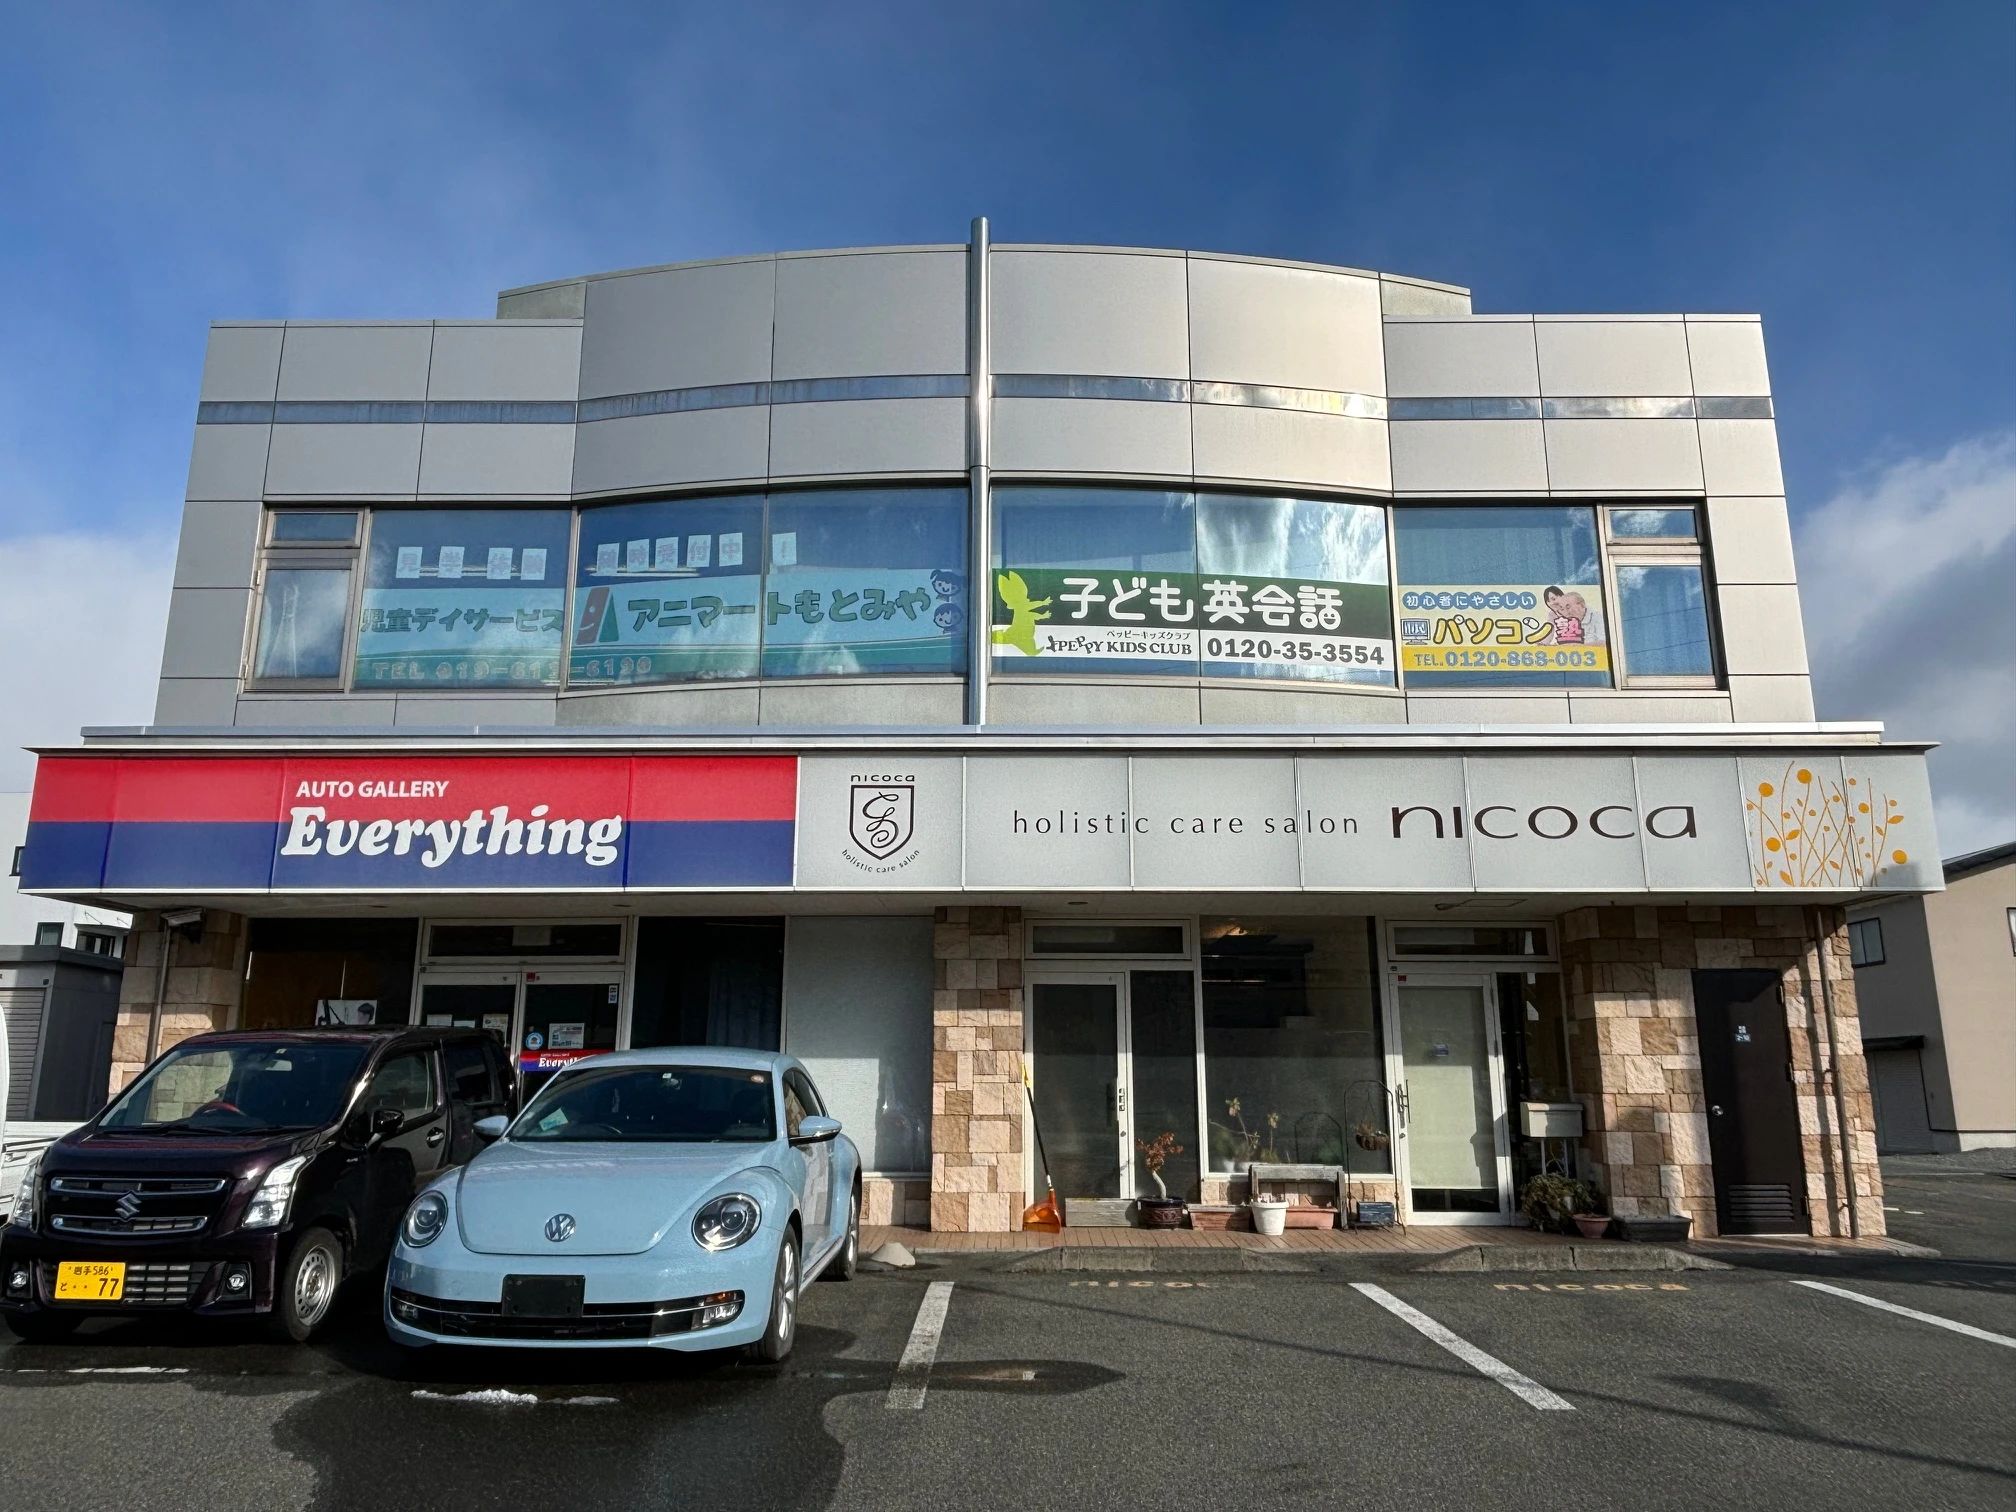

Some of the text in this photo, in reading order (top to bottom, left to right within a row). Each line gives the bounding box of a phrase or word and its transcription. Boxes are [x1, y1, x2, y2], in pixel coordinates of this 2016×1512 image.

[361, 586, 931, 633] 児童デイサービス アニマートもとみや
[1060, 577, 1343, 630] 子ども英会話
[1406, 594, 1535, 607] 初心者にやさしい
[1058, 635, 1192, 655] PEPPY KIDS CLUB
[1207, 637, 1384, 665] 0120-35-3554
[1445, 650, 1597, 667] 0120-868-003
[372, 662, 425, 680] TEL
[850, 774, 915, 782] nicoca
[296, 781, 450, 798] AUTO GALLERY
[1013, 805, 1698, 839] holistic care salon nicoca
[280, 804, 623, 868] Everything
[842, 849, 873, 873] holistic
[899, 850, 920, 868] salon
